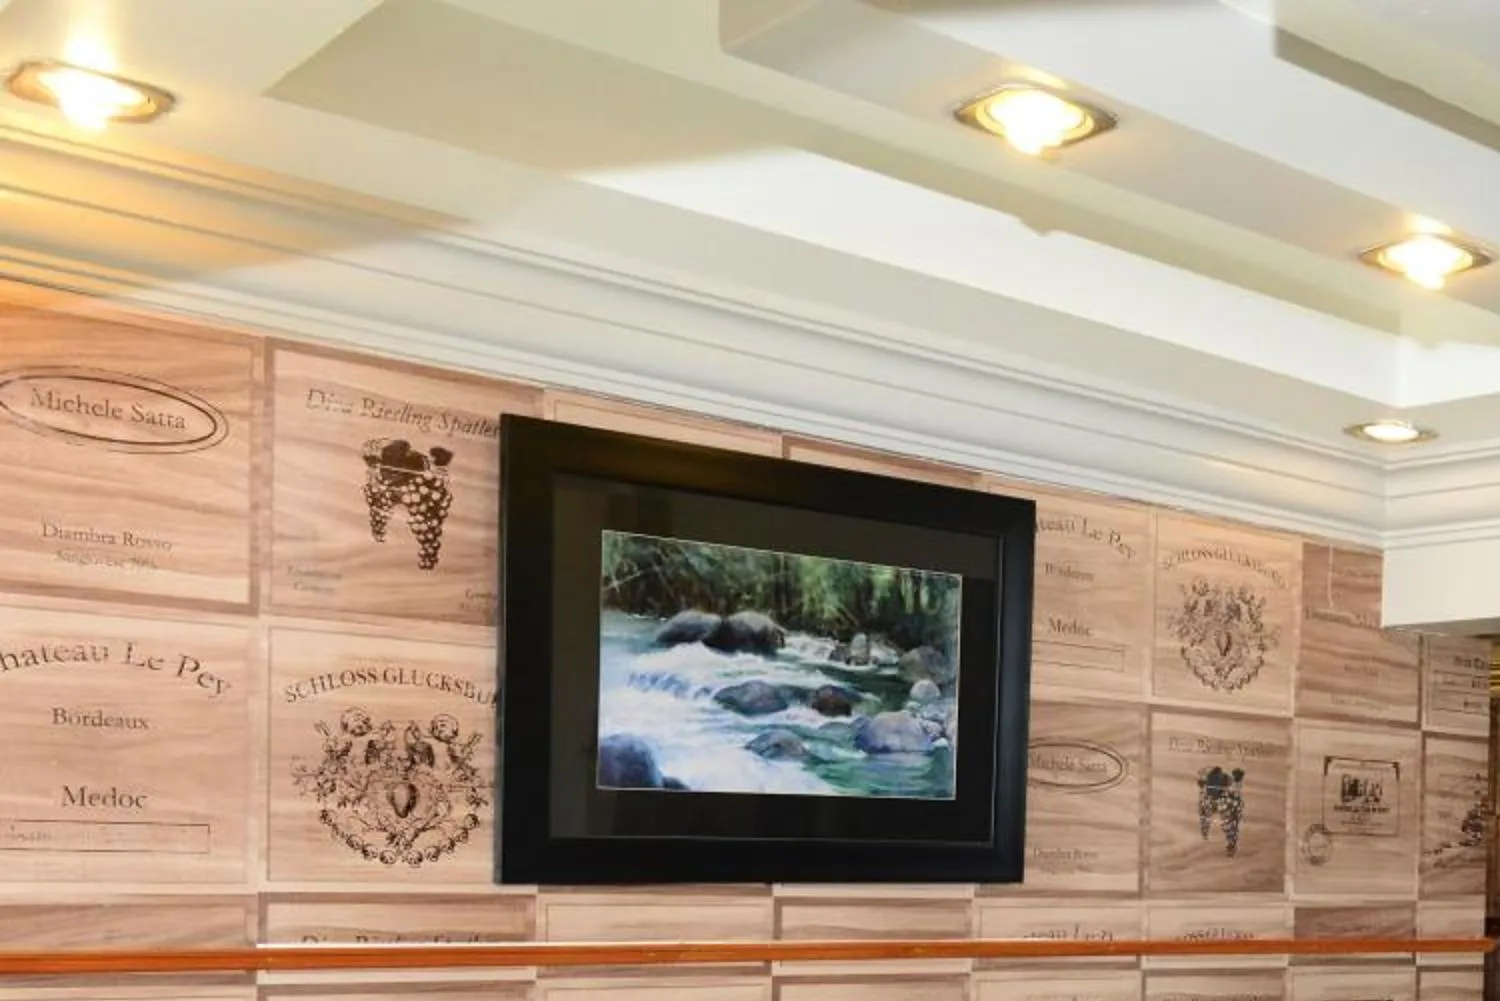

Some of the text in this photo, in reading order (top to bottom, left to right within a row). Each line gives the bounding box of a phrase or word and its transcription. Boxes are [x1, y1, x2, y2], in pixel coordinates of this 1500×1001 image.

[121, 641, 164, 670] Le
[286, 667, 497, 708] SCHLOSS GLUCKSBU
[52, 707, 150, 729] Bordeaux
[61, 785, 148, 808] Medoc
